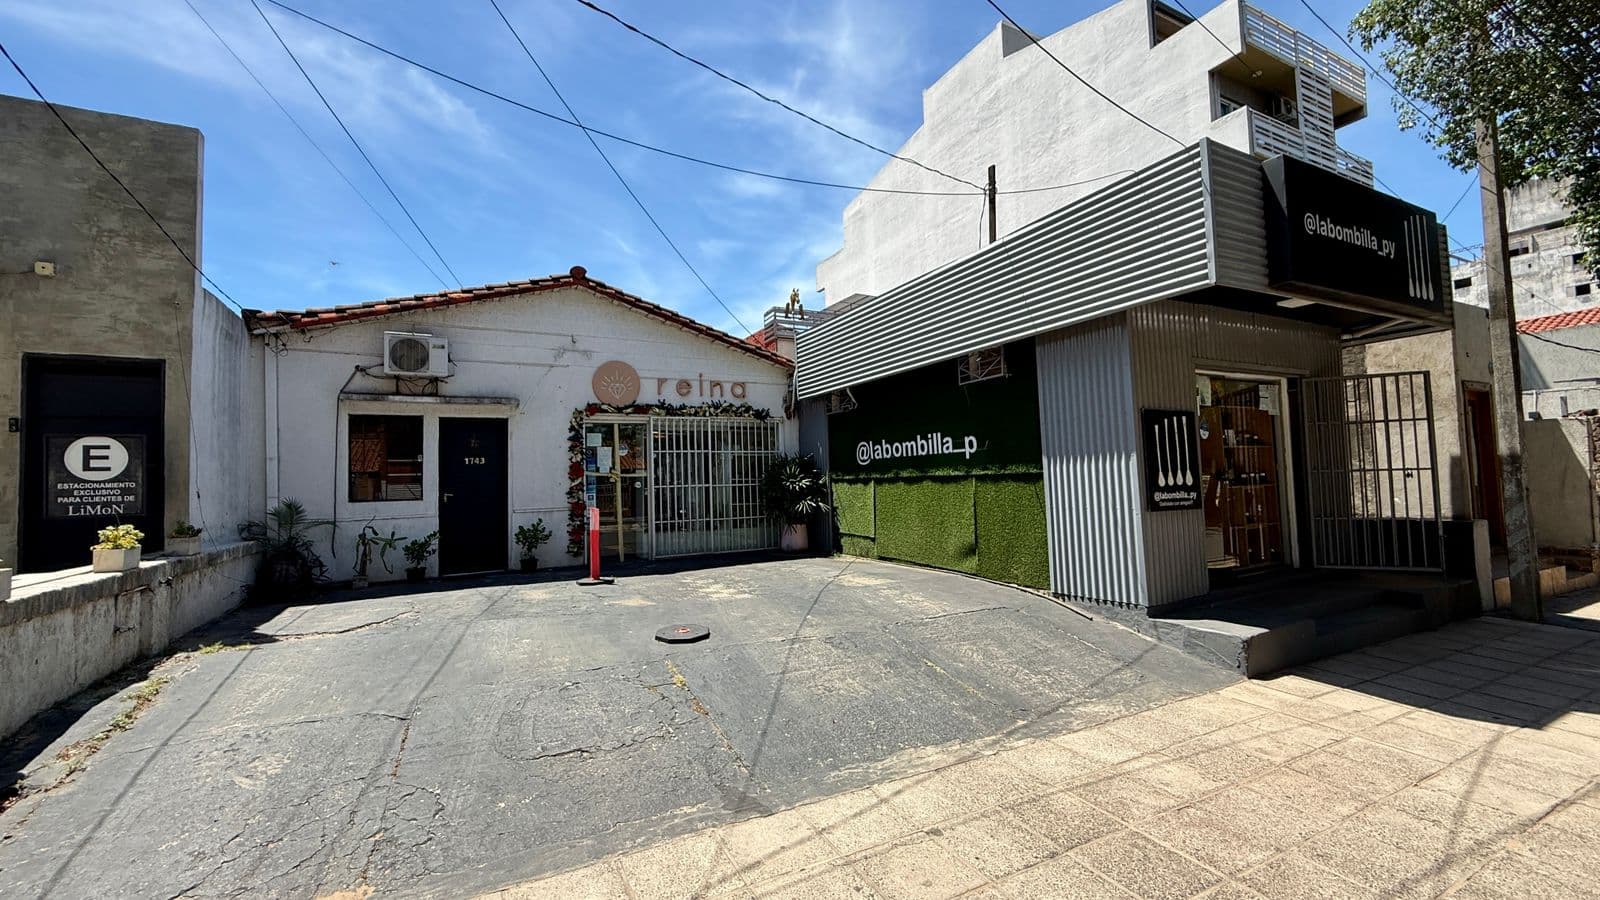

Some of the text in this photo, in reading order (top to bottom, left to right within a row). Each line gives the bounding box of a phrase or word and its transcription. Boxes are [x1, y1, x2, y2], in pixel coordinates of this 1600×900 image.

[1304, 212, 1396, 259] @labombilla_py
[657, 373, 746, 398] reina
[82, 445, 112, 471] E
[464, 457, 486, 465] 1743
[57, 482, 136, 490] ESTACIONAMIENTO
[82, 495, 122, 503] CLIENTES
[68, 504, 125, 516] LiMoN
